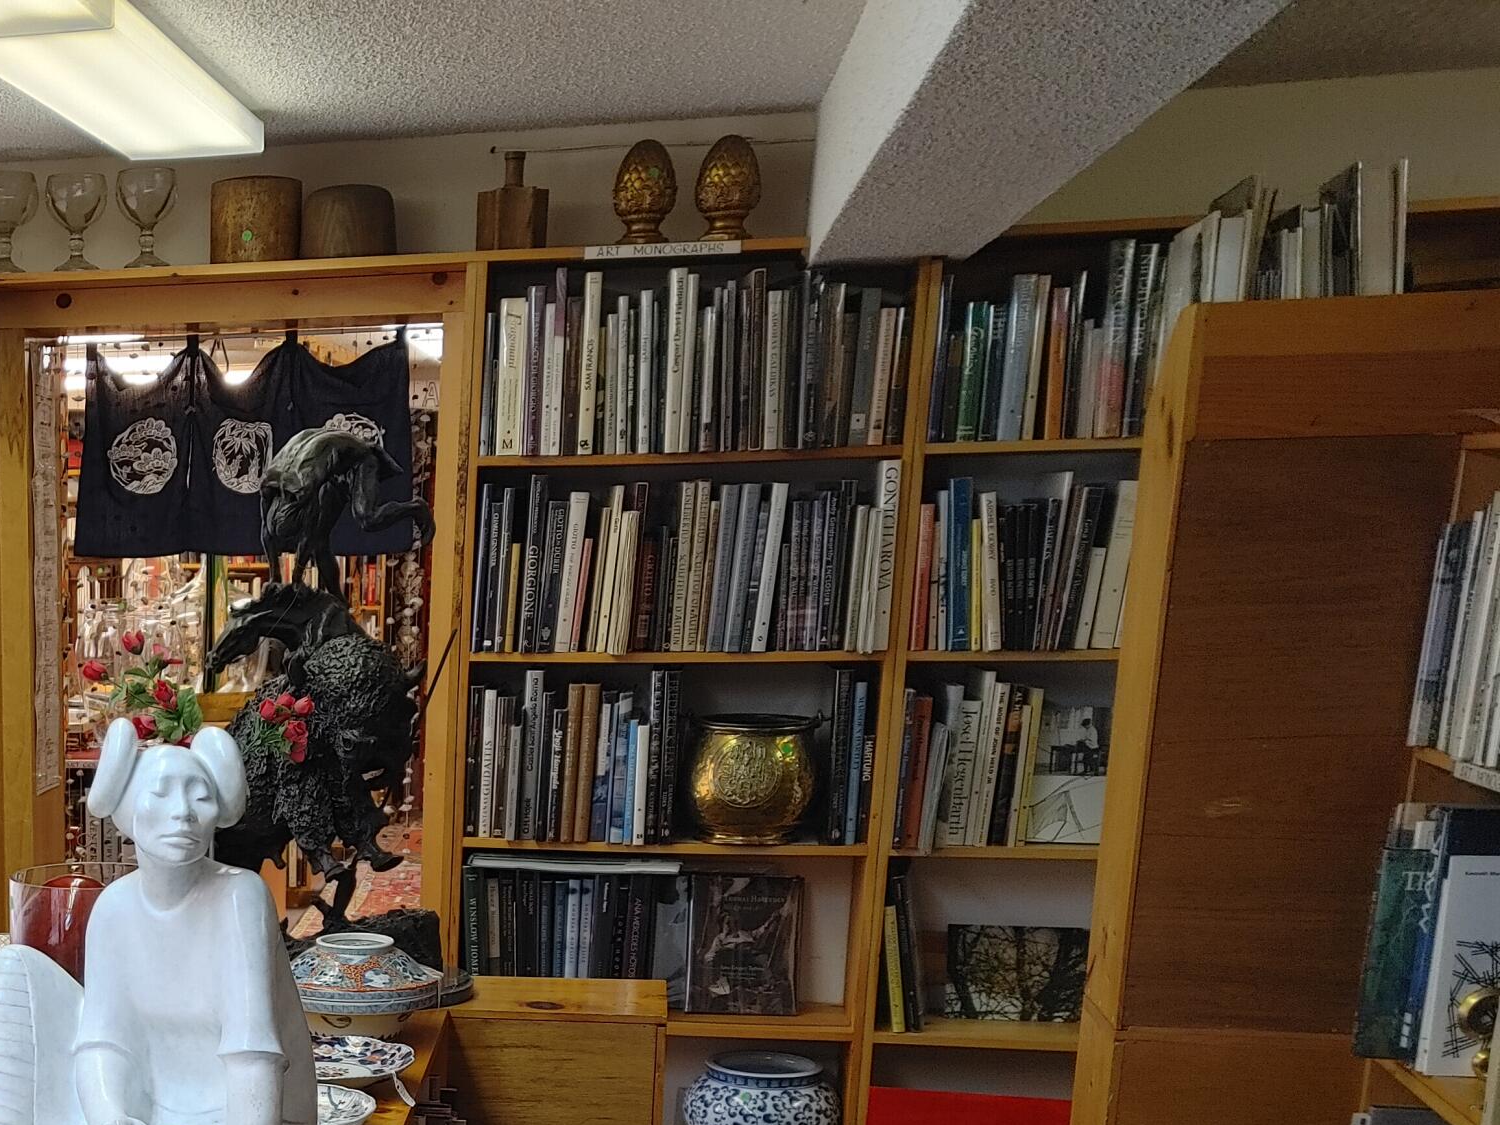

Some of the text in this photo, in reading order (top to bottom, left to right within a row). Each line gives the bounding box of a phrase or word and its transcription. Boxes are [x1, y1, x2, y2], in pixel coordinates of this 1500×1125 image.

[596, 243, 725, 257] ART MONOGRAPHS
[584, 338, 594, 391] SAM FRANCIS
[530, 375, 539, 414] GIORGIO
[555, 508, 566, 540] GIOTTO
[681, 486, 694, 545] GISLEBERTUS
[697, 486, 710, 544] GISLEBERTUS
[877, 466, 898, 592] GONTCHAROVA
[570, 523, 580, 550] GIOTTO
[822, 496, 838, 606] Andy Goldsworthy ENCLOSURE
[988, 533, 996, 561] GORKY
[524, 545, 539, 619] GIORGIONE
[643, 554, 656, 597] GIOTTO
[687, 611, 698, 646] AUTUN
[530, 677, 539, 702] Roma
[663, 680, 679, 779] FREDERICK HART
[961, 708, 977, 744] Josef
[996, 706, 1004, 726] MOST
[551, 729, 564, 790] Shoji Hamada
[861, 740, 874, 781] HARTUNG
[988, 757, 997, 775] HELD
[991, 737, 999, 755] JOHN
[469, 897, 479, 944] WINSLOW
[630, 897, 642, 952] ANA MERCEDES
